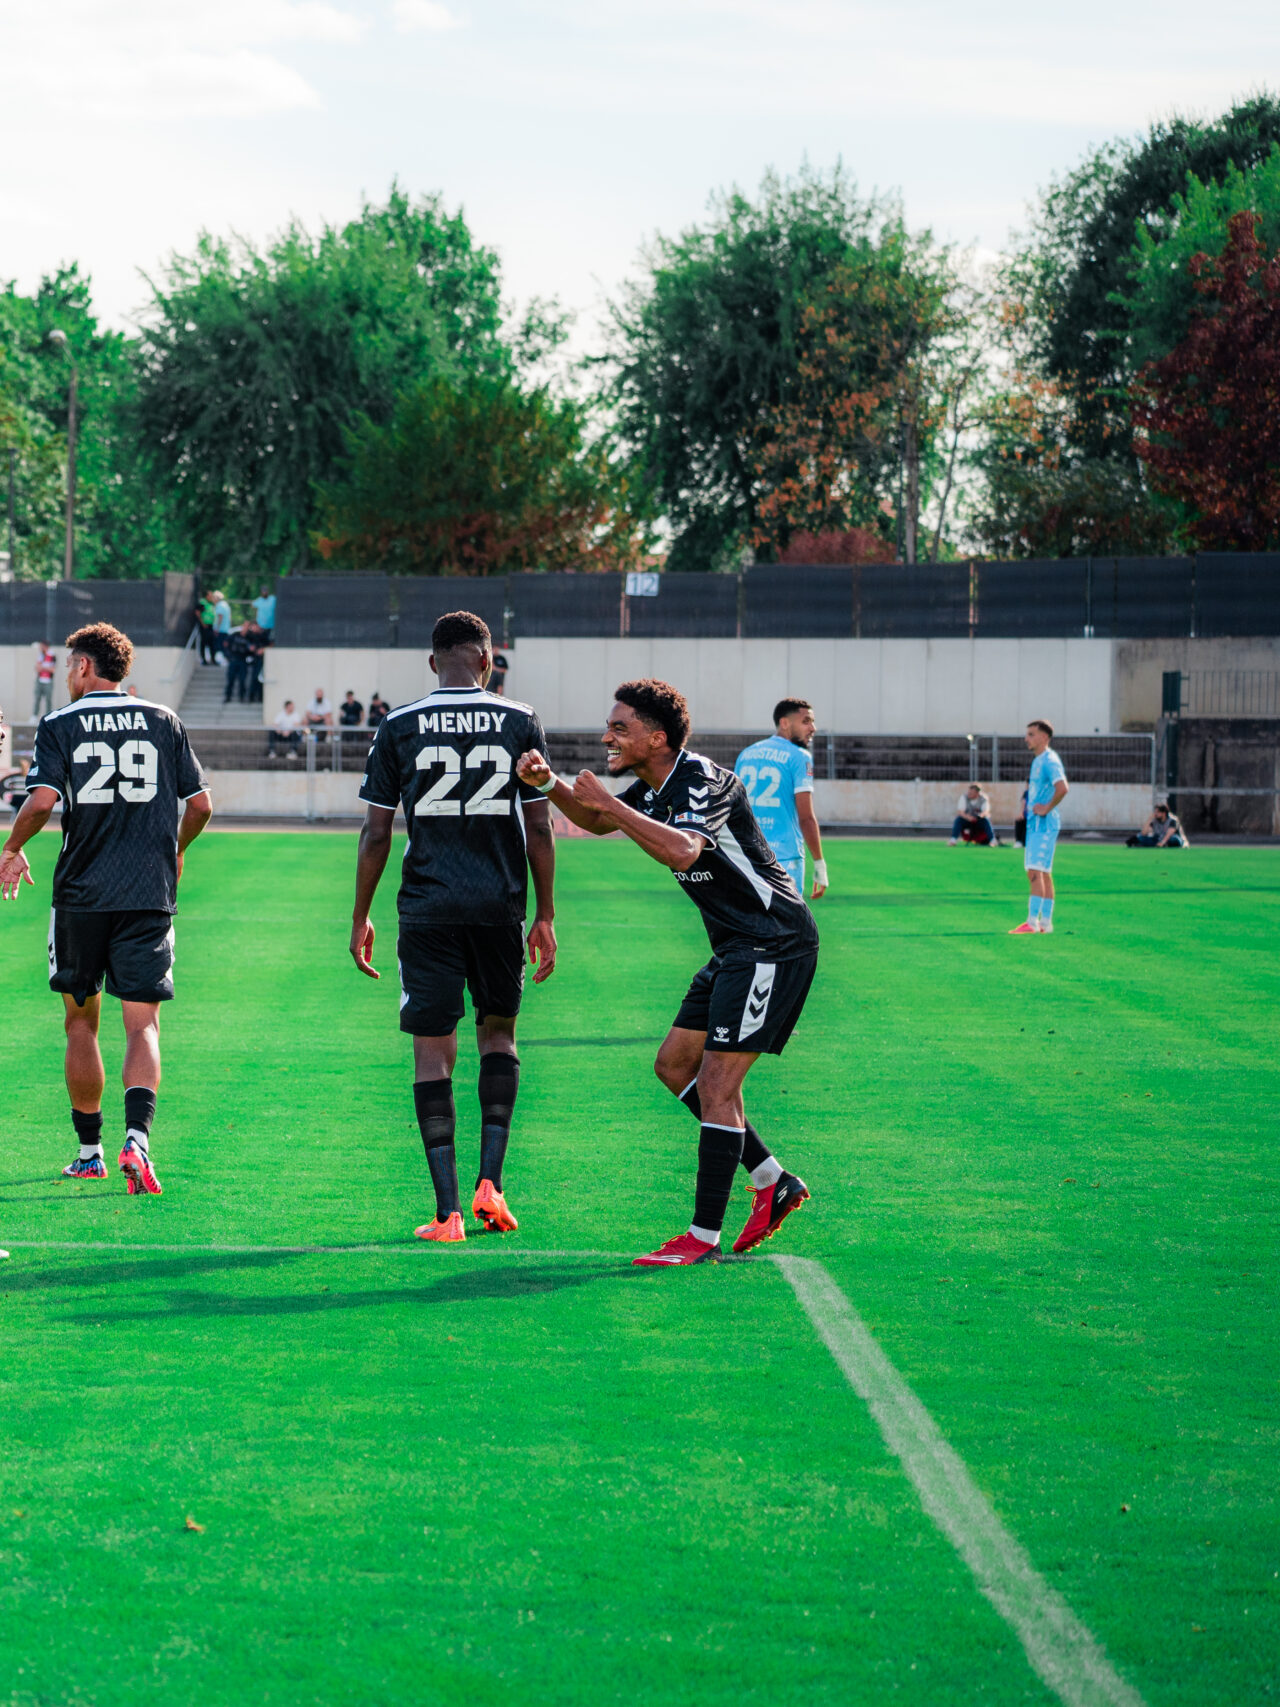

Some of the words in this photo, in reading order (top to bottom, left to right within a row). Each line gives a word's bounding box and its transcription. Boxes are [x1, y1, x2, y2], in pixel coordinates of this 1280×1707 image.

[630, 576, 657, 595] 12
[78, 711, 148, 733] VIANA
[418, 711, 506, 734] MENDY
[73, 740, 158, 804] 29
[414, 745, 512, 816] 22
[740, 765, 781, 808] 22
